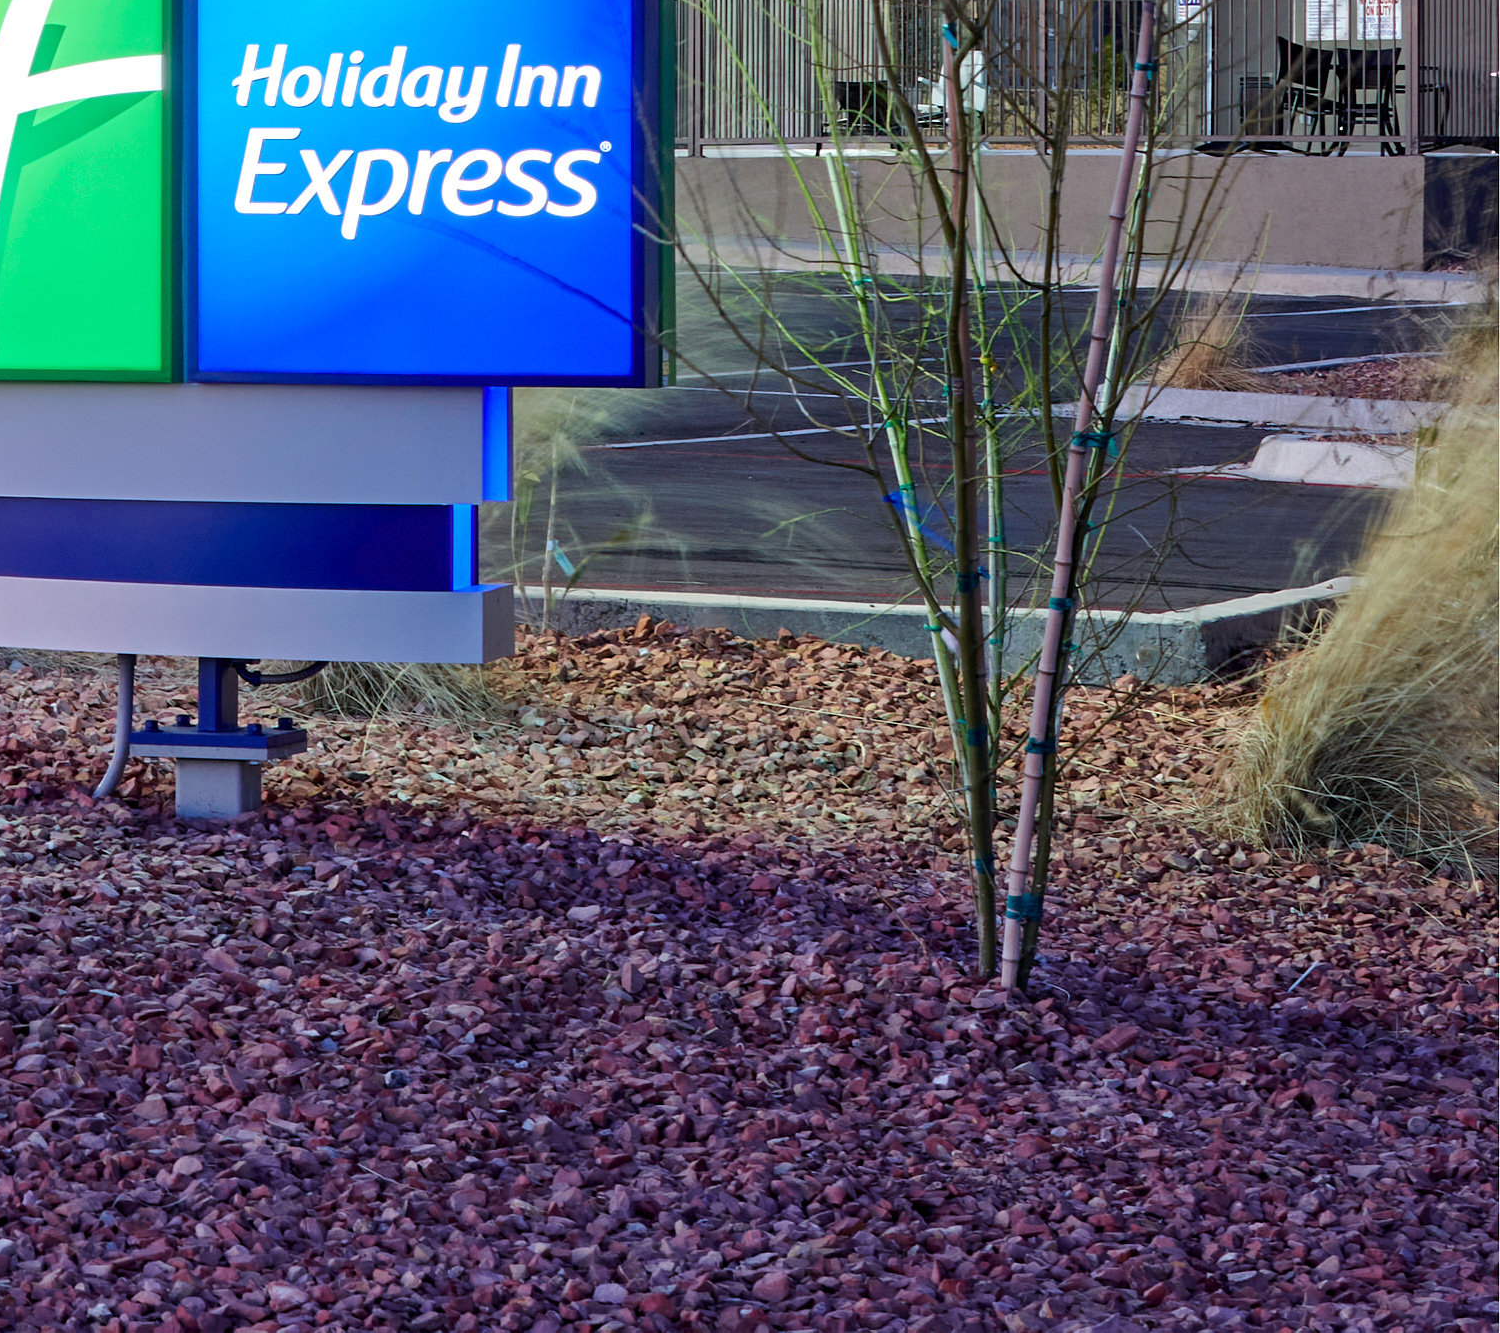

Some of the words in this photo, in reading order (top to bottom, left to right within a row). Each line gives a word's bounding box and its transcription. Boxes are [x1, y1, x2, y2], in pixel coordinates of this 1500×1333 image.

[232, 44, 488, 124] Holiday
[496, 44, 601, 108] Inn
[234, 127, 602, 240] Express
